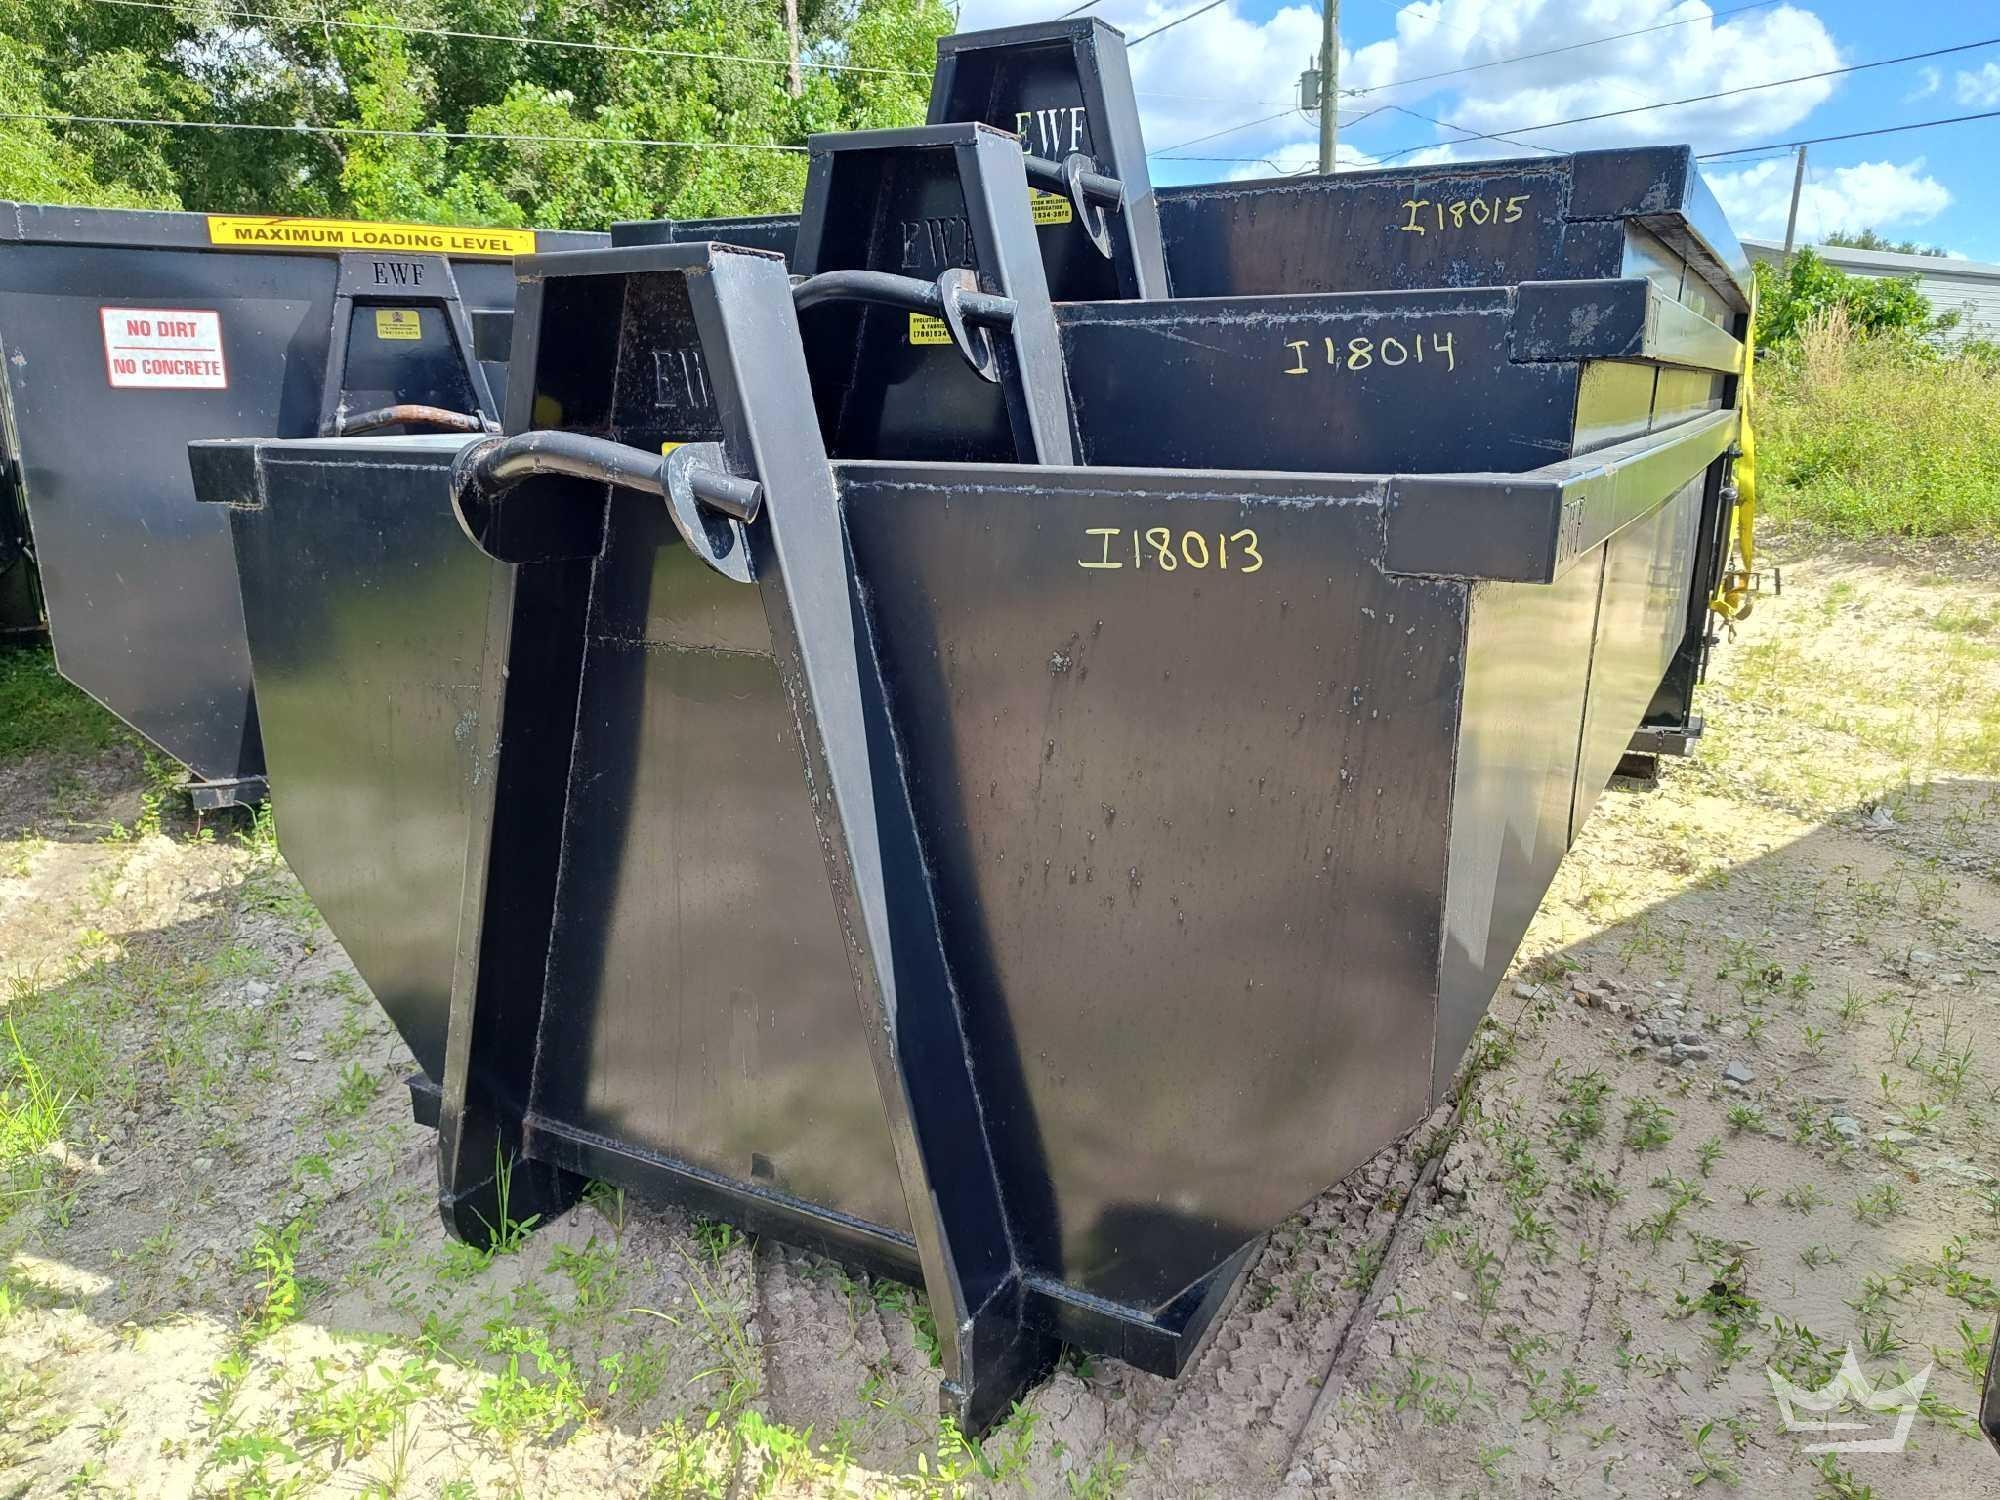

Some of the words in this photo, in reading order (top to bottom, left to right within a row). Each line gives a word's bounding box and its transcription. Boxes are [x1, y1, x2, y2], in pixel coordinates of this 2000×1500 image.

[1015, 107, 1086, 155] EWF
[1401, 195, 1530, 235] I18015
[235, 229, 344, 243] MAXIMUM
[352, 231, 443, 247] LOADING
[451, 236, 513, 251] LEVEL
[373, 262, 425, 286] EWF
[127, 320, 151, 337] NO
[157, 321, 197, 338] DIRT
[113, 359, 136, 374] NO
[142, 360, 221, 376] CONCRETE
[1283, 332, 1455, 374] I18014
[1078, 527, 1263, 573] I18013
